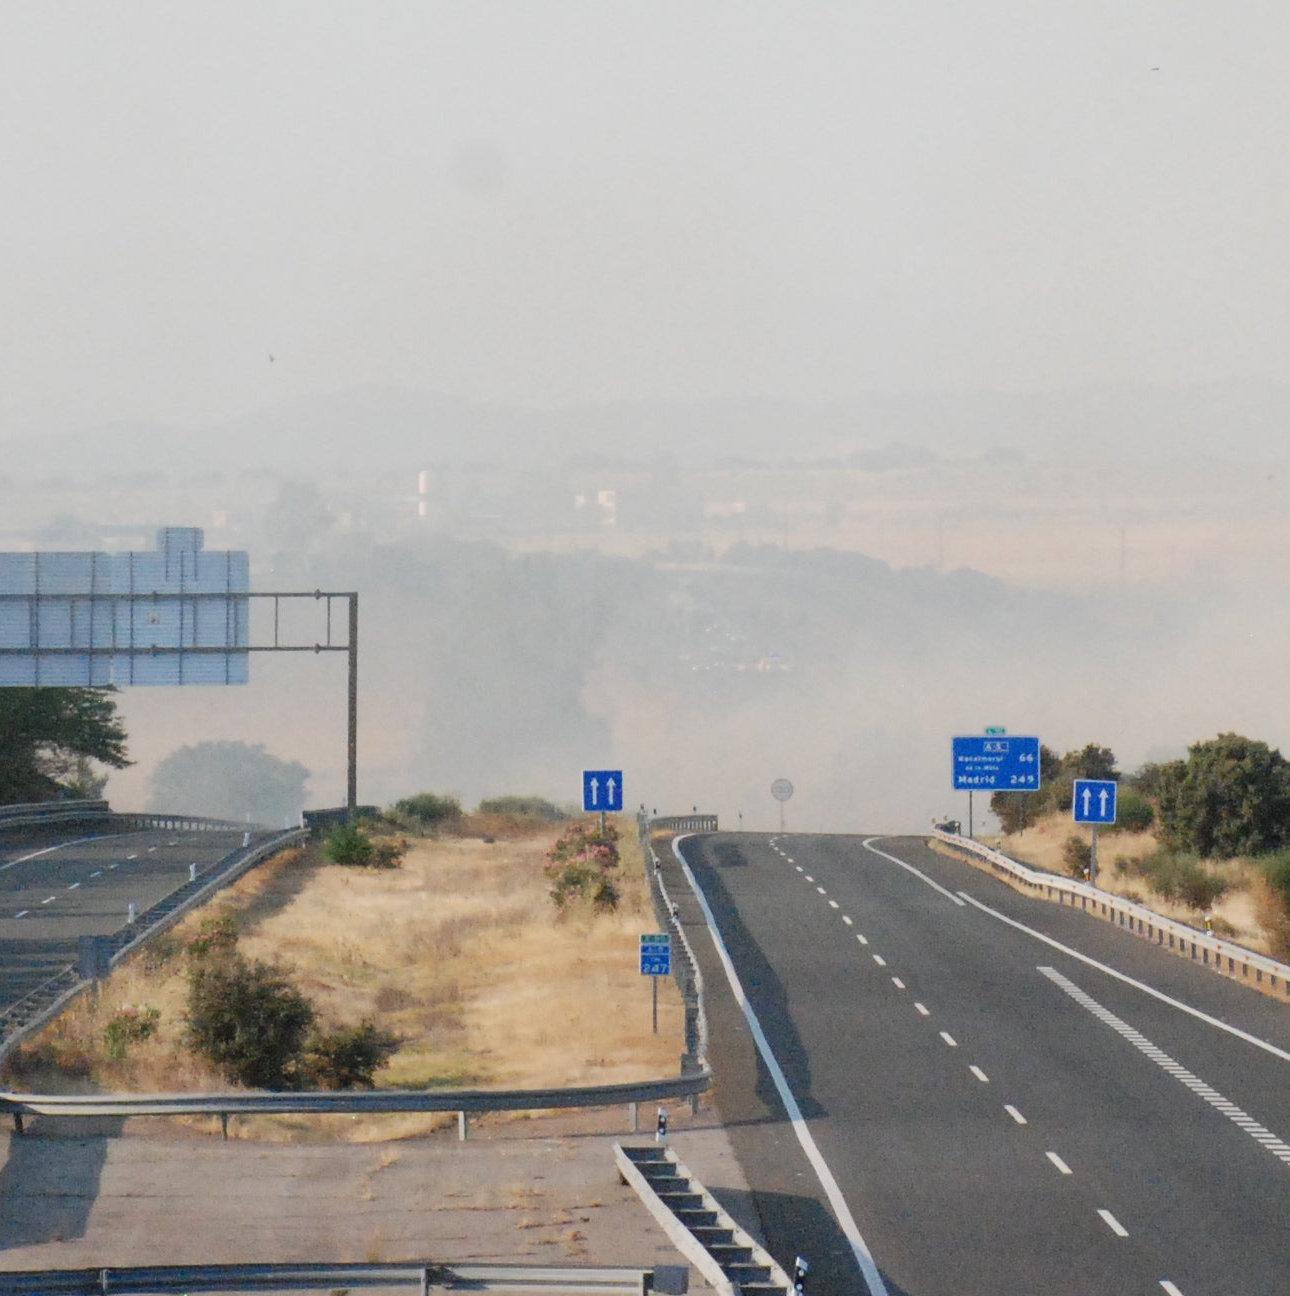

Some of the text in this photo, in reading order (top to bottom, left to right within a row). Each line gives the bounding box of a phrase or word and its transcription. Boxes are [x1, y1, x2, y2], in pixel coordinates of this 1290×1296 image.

[1019, 753, 1034, 763] 66
[958, 775, 1035, 784] Madrid 249
